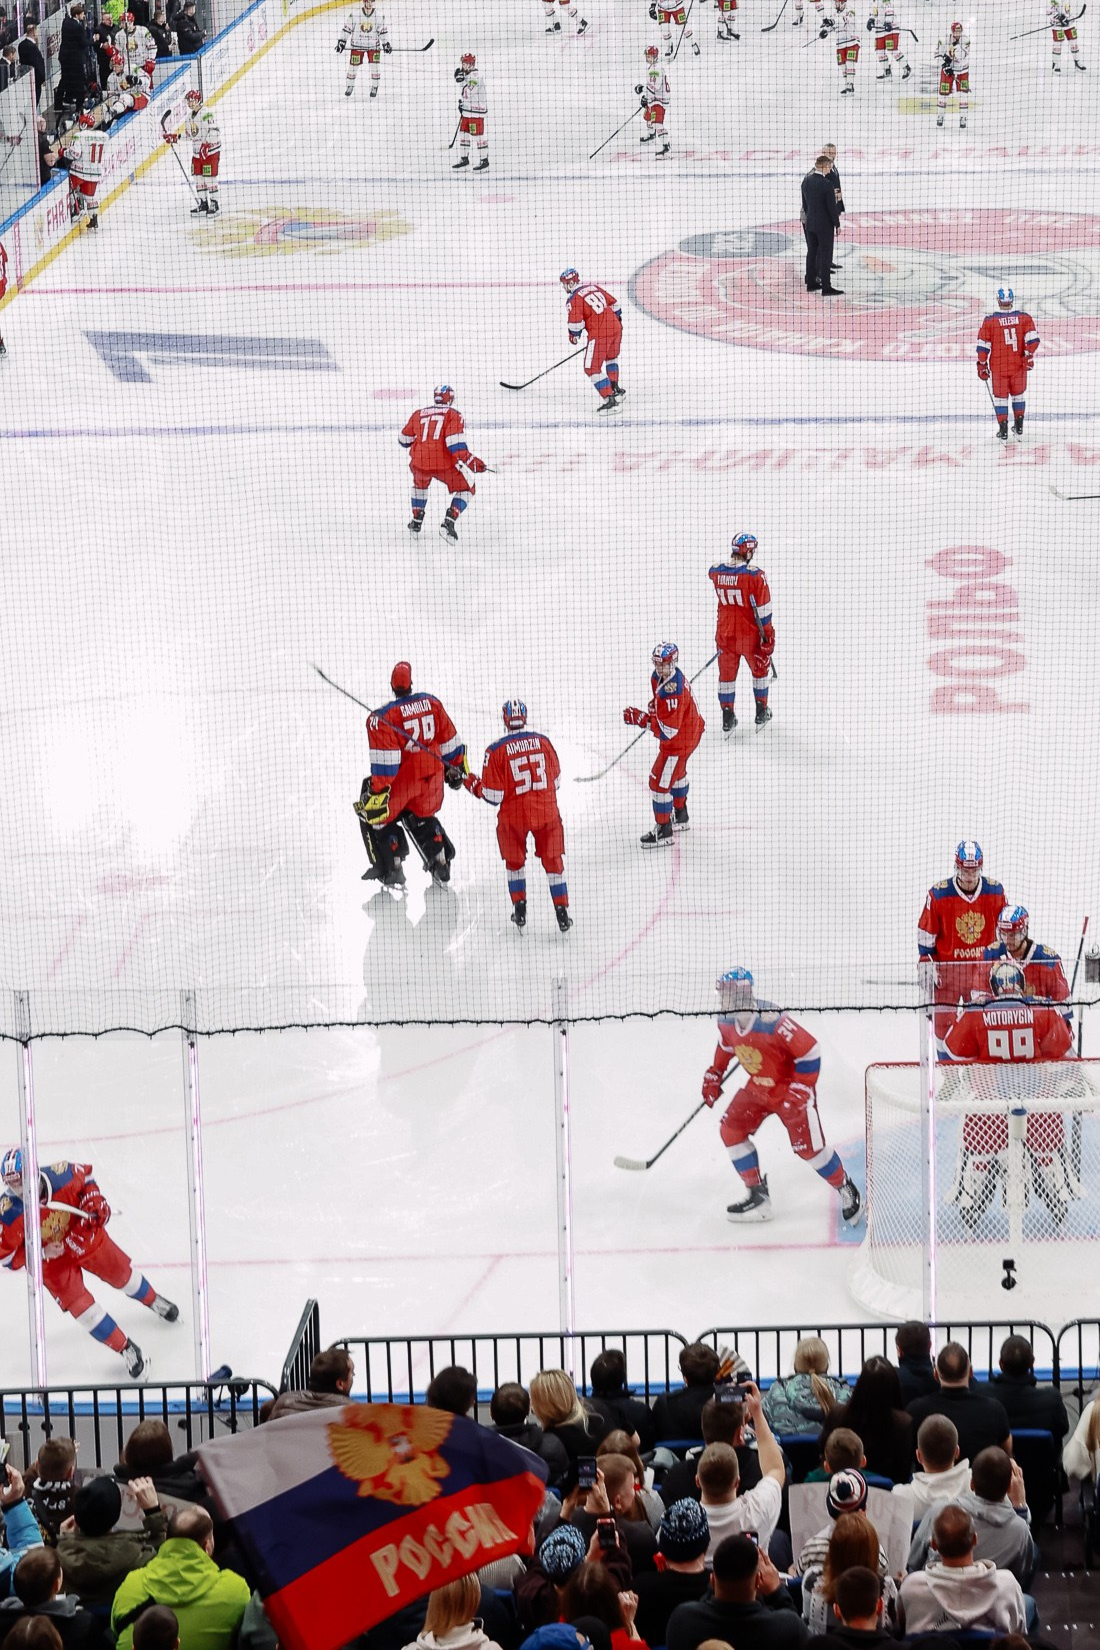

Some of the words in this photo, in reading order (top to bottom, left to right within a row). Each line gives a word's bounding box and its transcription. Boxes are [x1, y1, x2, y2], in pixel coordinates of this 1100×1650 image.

[91, 142, 104, 164] 11
[1003, 327, 1018, 353] 4
[925, 544, 1031, 716] РОЛЬФ
[505, 737, 542, 756] AIMURZIN
[509, 752, 549, 796] 53
[777, 1015, 798, 1043] 34
[982, 1009, 1035, 1027] MOTORYGIN
[987, 1027, 1035, 1061] 99
[369, 1502, 519, 1598] РОССИЯ
